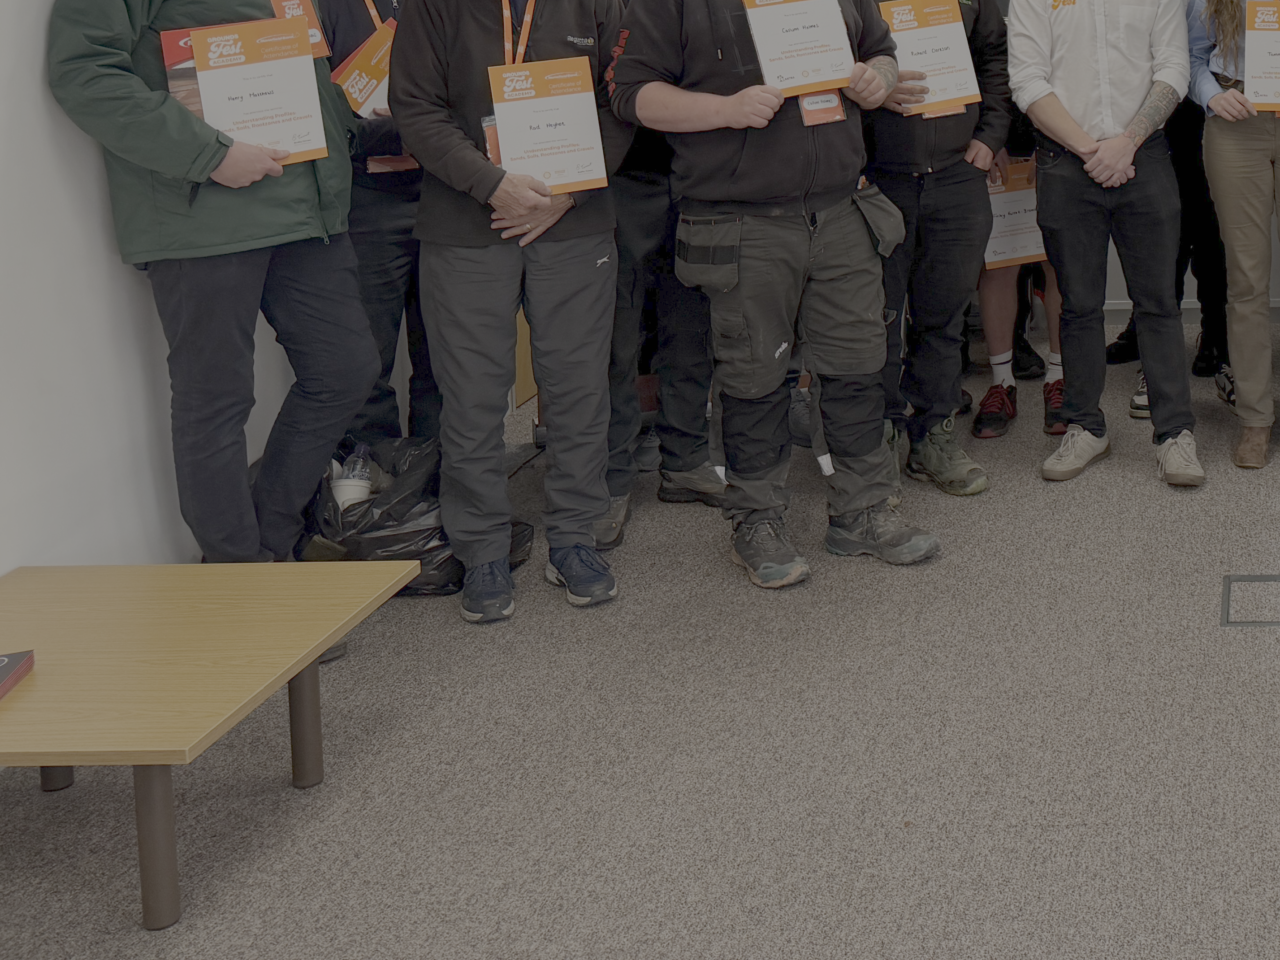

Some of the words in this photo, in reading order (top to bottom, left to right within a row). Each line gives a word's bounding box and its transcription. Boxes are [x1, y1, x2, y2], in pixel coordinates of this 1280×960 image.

[208, 40, 242, 59] Fest
[261, 44, 290, 53] Certificate
[503, 76, 532, 92] Fest
